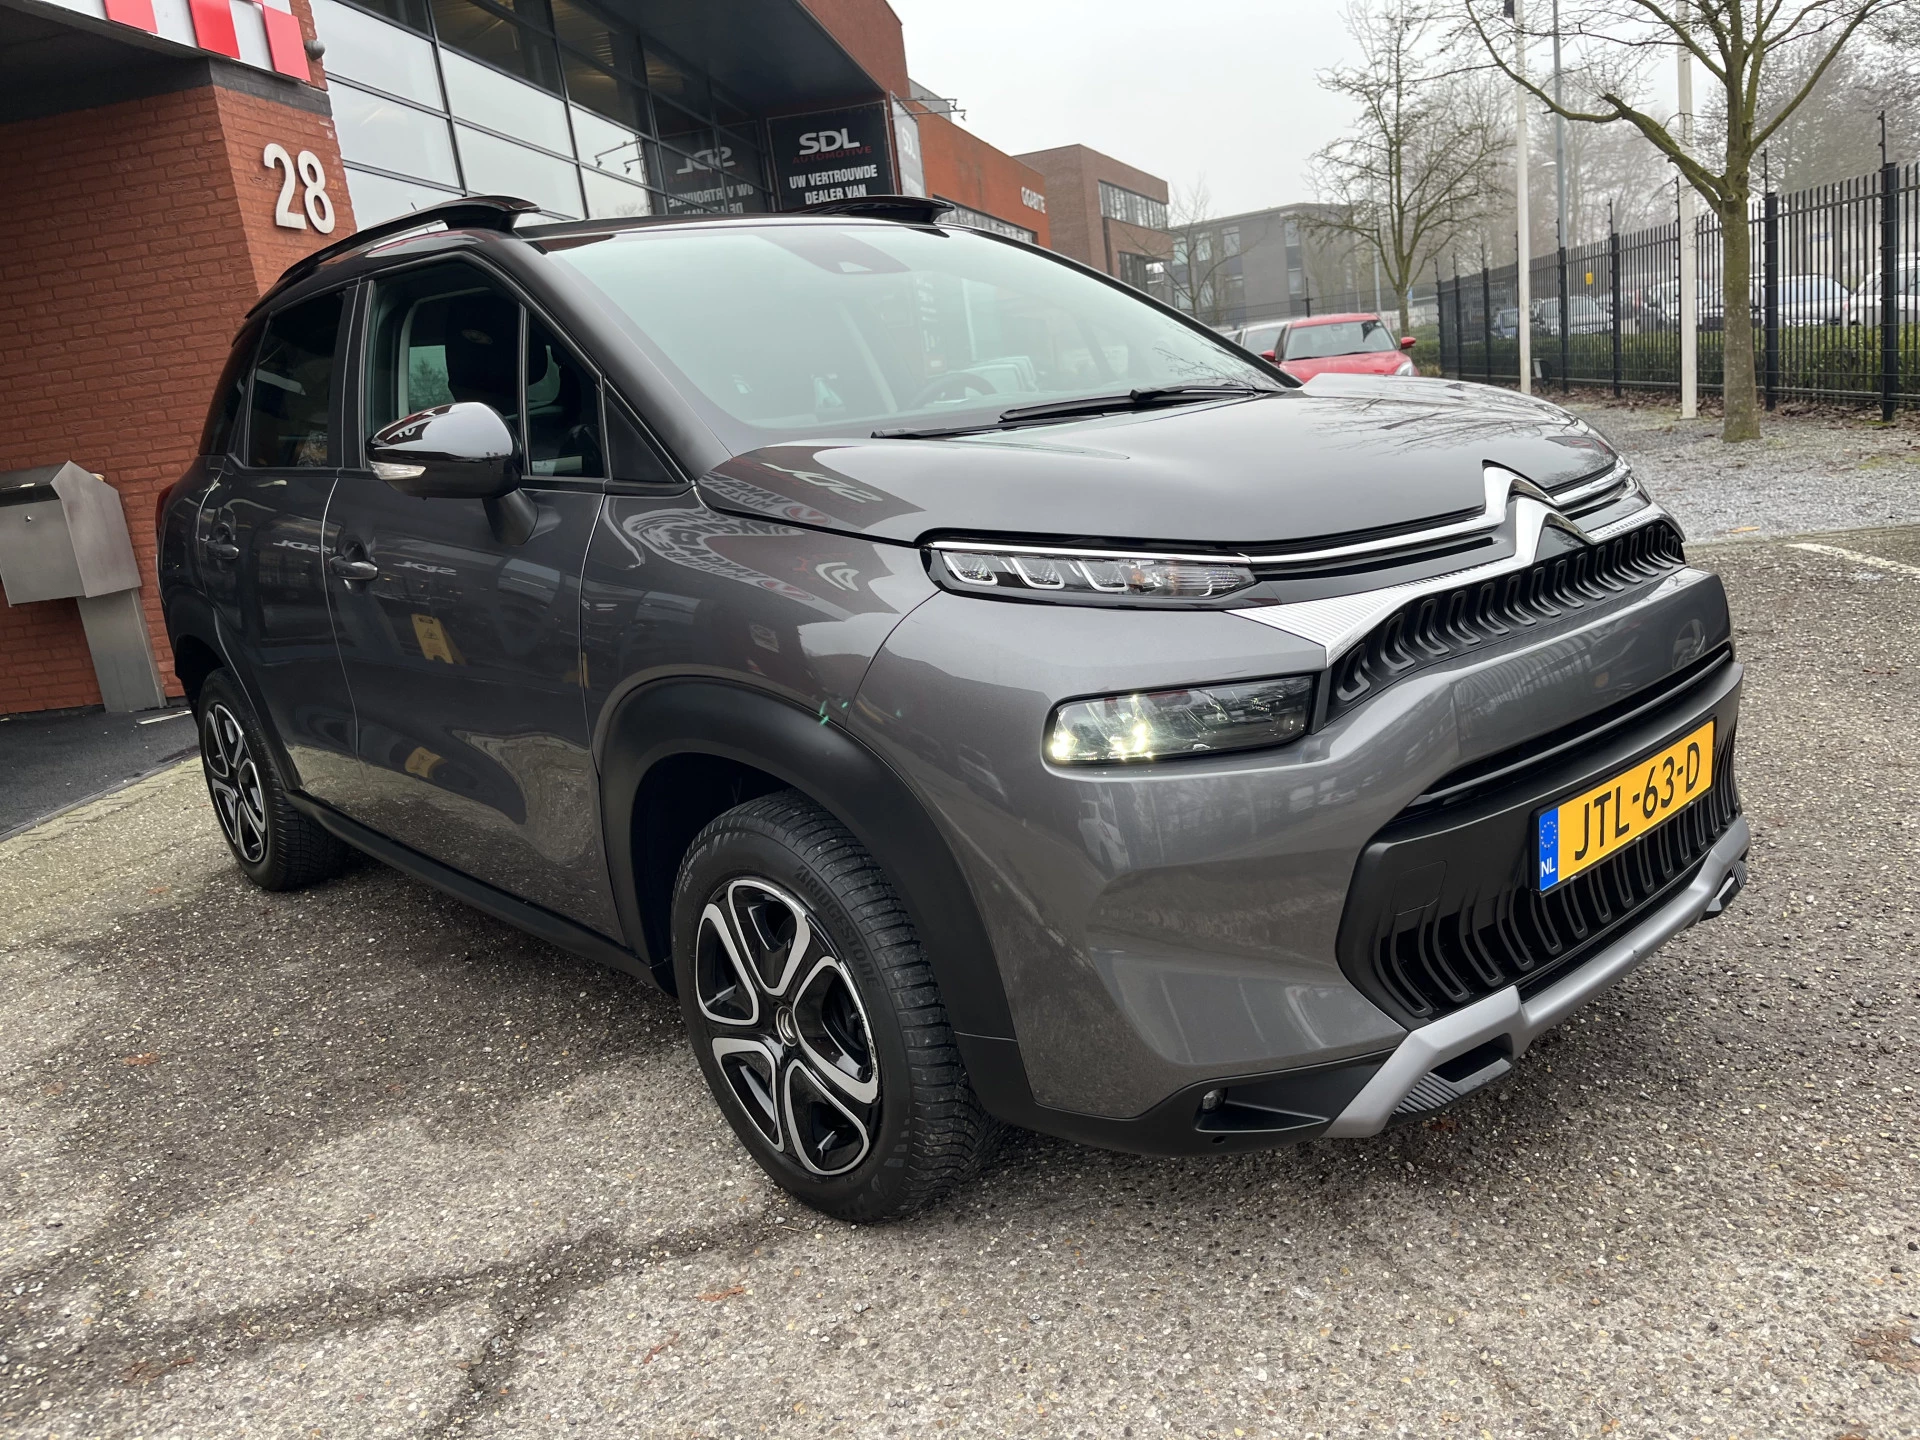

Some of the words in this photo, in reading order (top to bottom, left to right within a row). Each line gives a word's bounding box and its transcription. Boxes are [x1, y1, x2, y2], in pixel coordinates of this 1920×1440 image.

[799, 128, 860, 155] SDL
[792, 146, 873, 164] AUTOMOTIVE
[263, 143, 335, 233] 28
[789, 174, 807, 189] UW
[808, 164, 878, 186] VERTROUWDE
[804, 187, 844, 205] DEALER
[845, 183, 867, 198] VAN
[1574, 741, 1700, 861] JTL-63-D
[1540, 857, 1556, 878] NL
